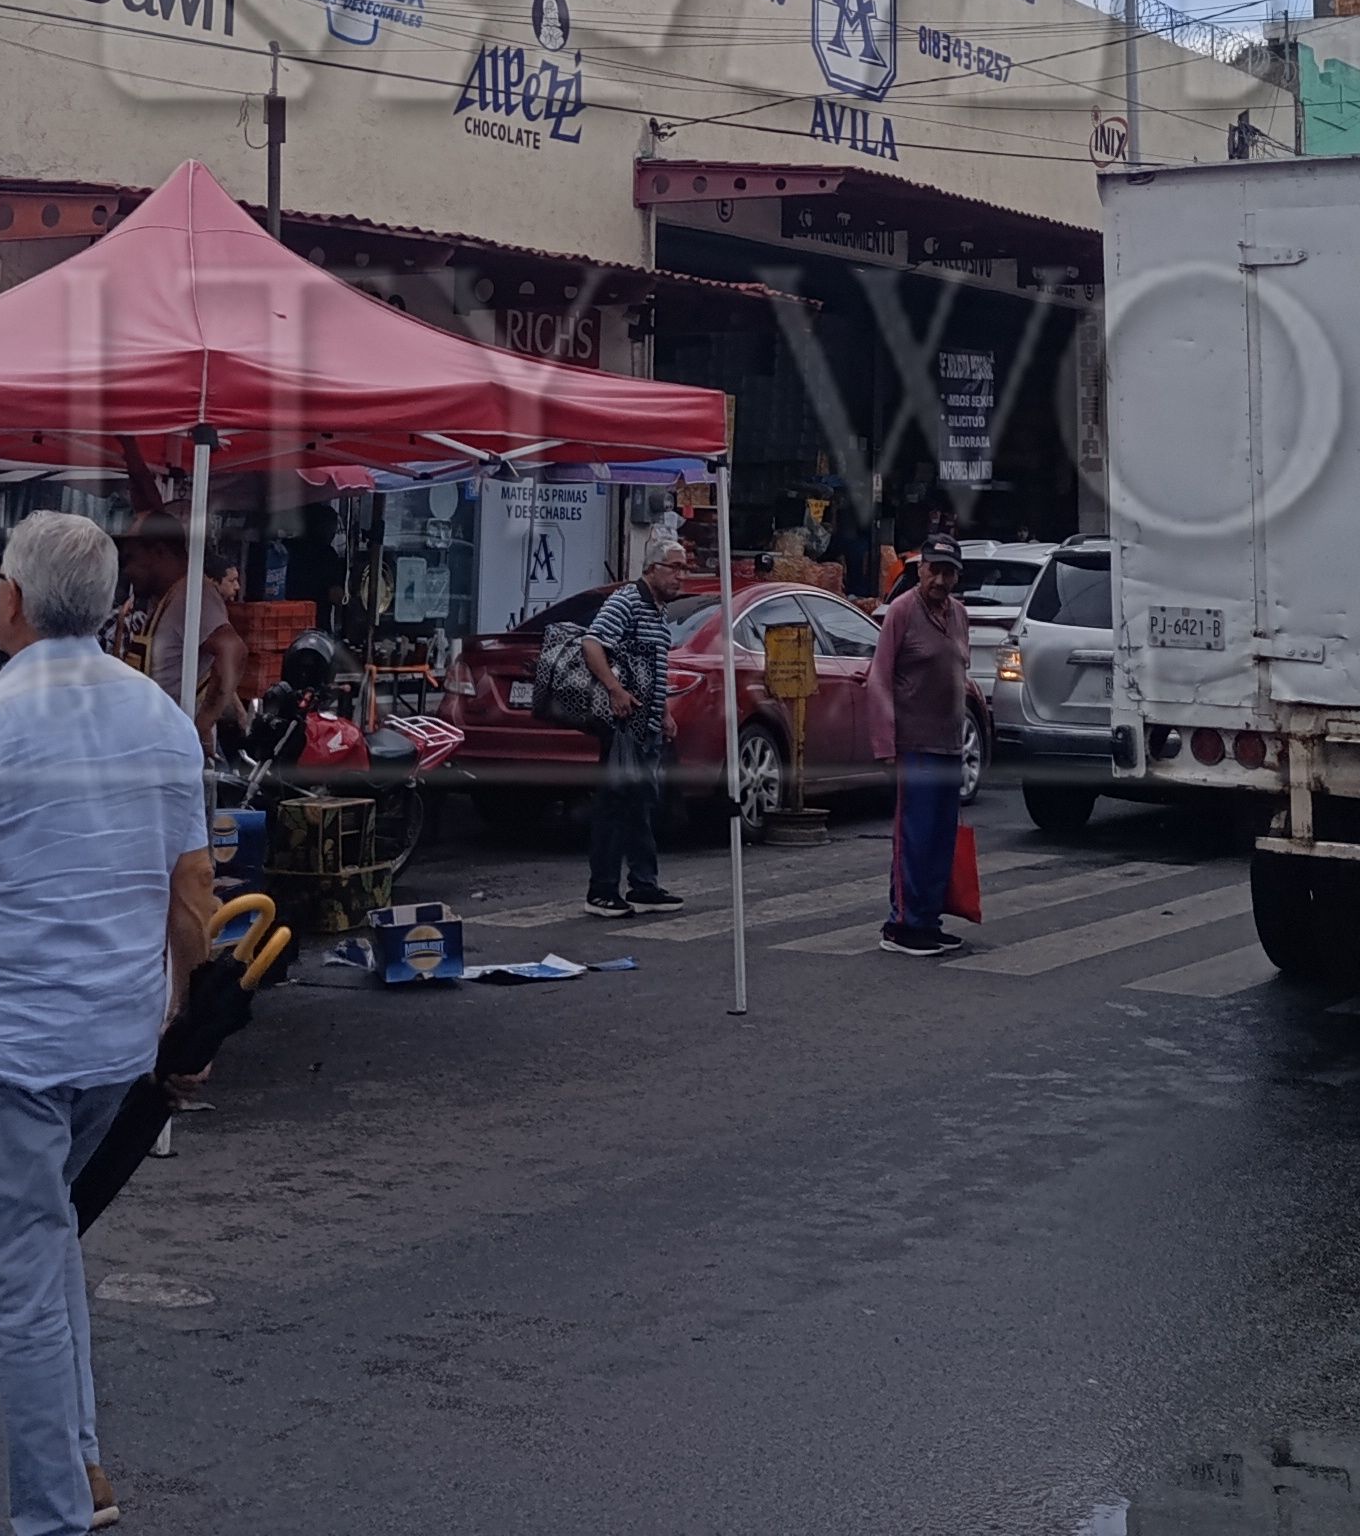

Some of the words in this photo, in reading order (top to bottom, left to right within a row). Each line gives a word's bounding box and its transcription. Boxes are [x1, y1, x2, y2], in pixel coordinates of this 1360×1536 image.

[464, 115, 541, 150] CHOCOLATE
[809, 97, 900, 162] AVILA
[505, 309, 594, 360] RICH'S
[501, 485, 550, 502] MATERAS
[552, 488, 588, 504] PRIMAS
[506, 504, 512, 518] Y
[1149, 615, 1222, 638] PJ-6421-B
